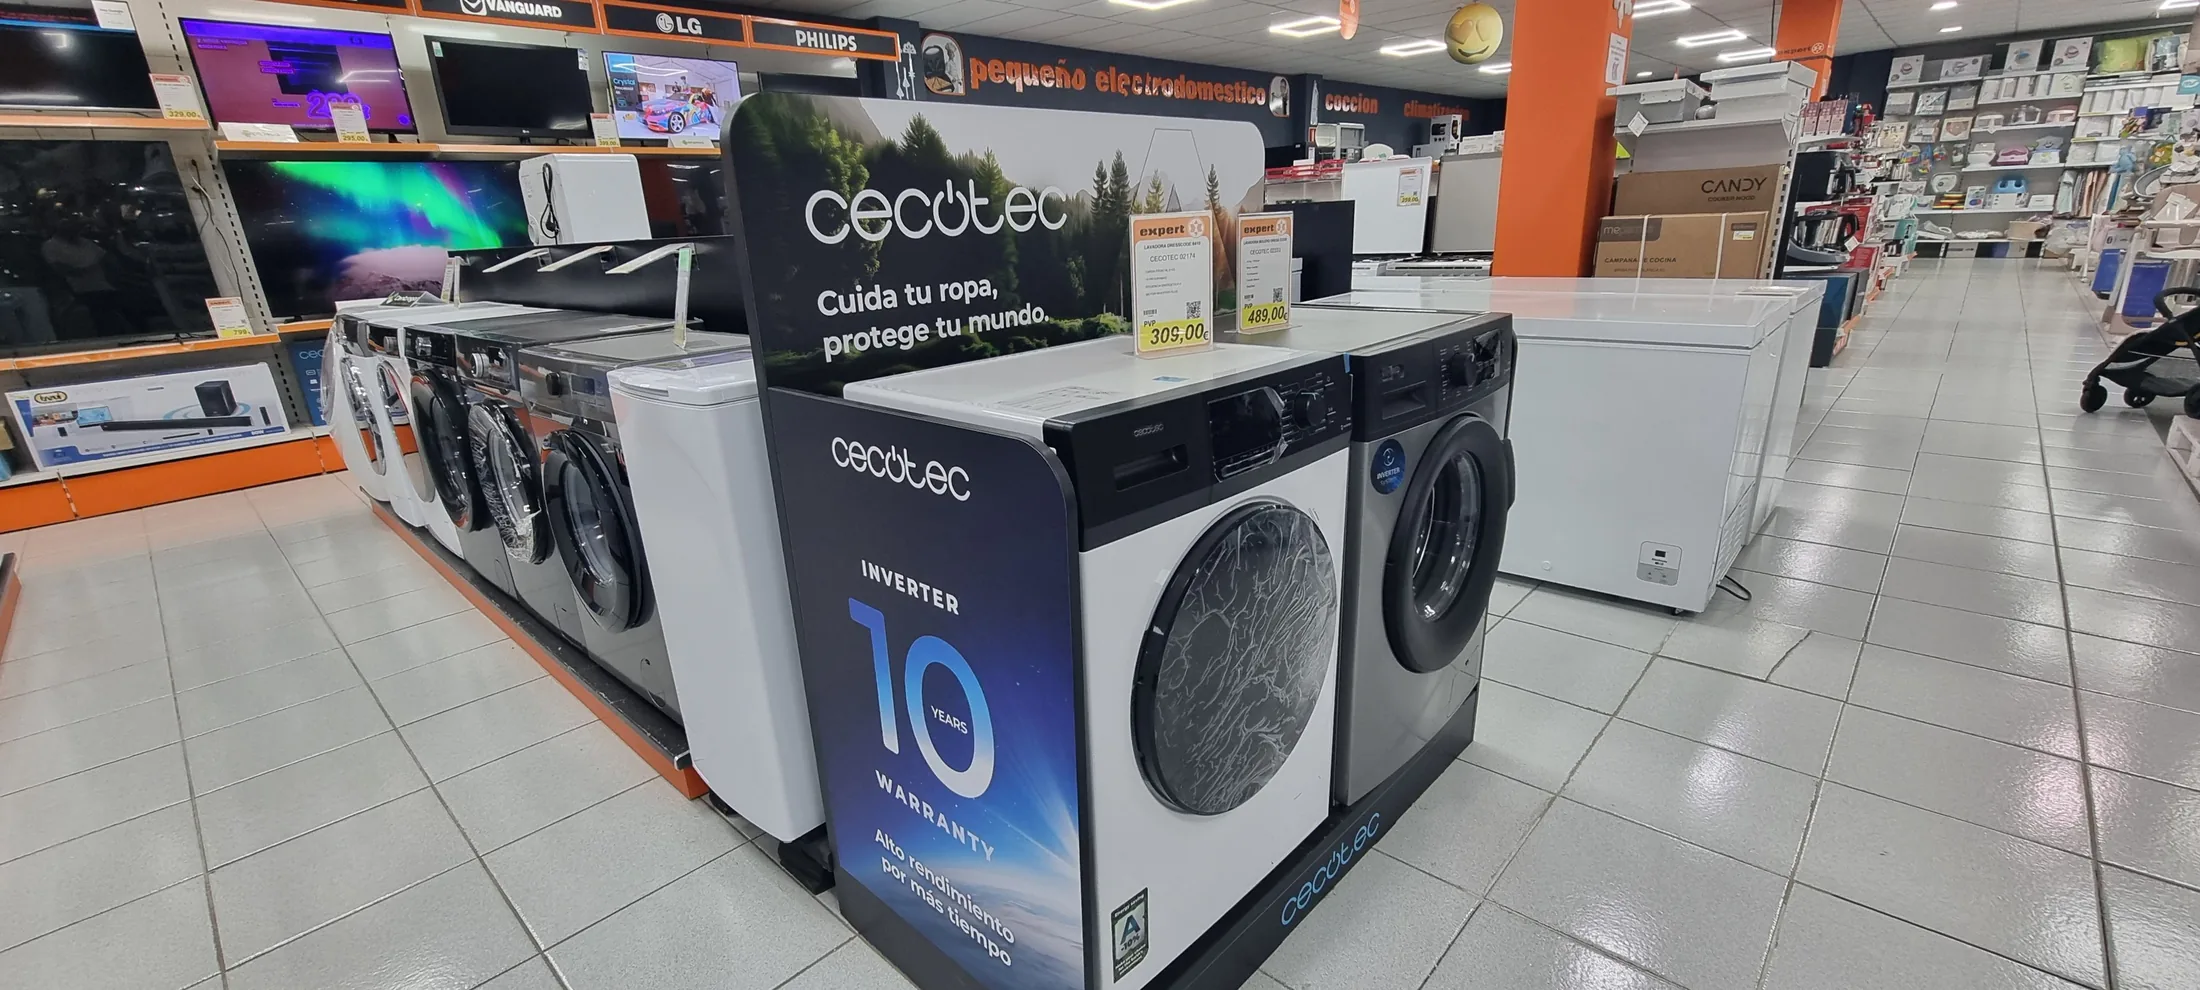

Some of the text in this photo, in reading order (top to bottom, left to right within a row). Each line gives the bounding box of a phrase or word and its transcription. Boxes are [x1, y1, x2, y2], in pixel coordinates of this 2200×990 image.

[486, 0, 562, 18] VANGUARD
[676, 16, 702, 35] LG
[795, 30, 857, 52] PHILIPS
[969, 57, 1266, 106] pequeño electrodomestico
[1325, 92, 1379, 115] coccion
[1701, 177, 1768, 194] CANDY
[804, 178, 1068, 245] cecotec
[1139, 224, 1185, 237] expert
[1243, 223, 1275, 235] expert
[1149, 253, 1178, 263] CECOTEC
[817, 278, 998, 316] Cuida tu ropa,
[1248, 305, 1289, 324] 489,00€
[823, 303, 1049, 363] protege tu mundo.
[1150, 322, 1210, 345] 309,00€
[831, 436, 971, 502] cecotec
[1376, 465, 1401, 480] INVERTER
[861, 558, 960, 616] INVERTER
[848, 597, 996, 799] 10
[930, 705, 969, 735] YEARS
[875, 768, 995, 863] WARRANTY
[1280, 812, 1381, 926] cecotec
[875, 828, 1016, 945] Alto rendimiento
[881, 856, 1013, 967] por más tiempo
[1119, 914, 1141, 945] A
